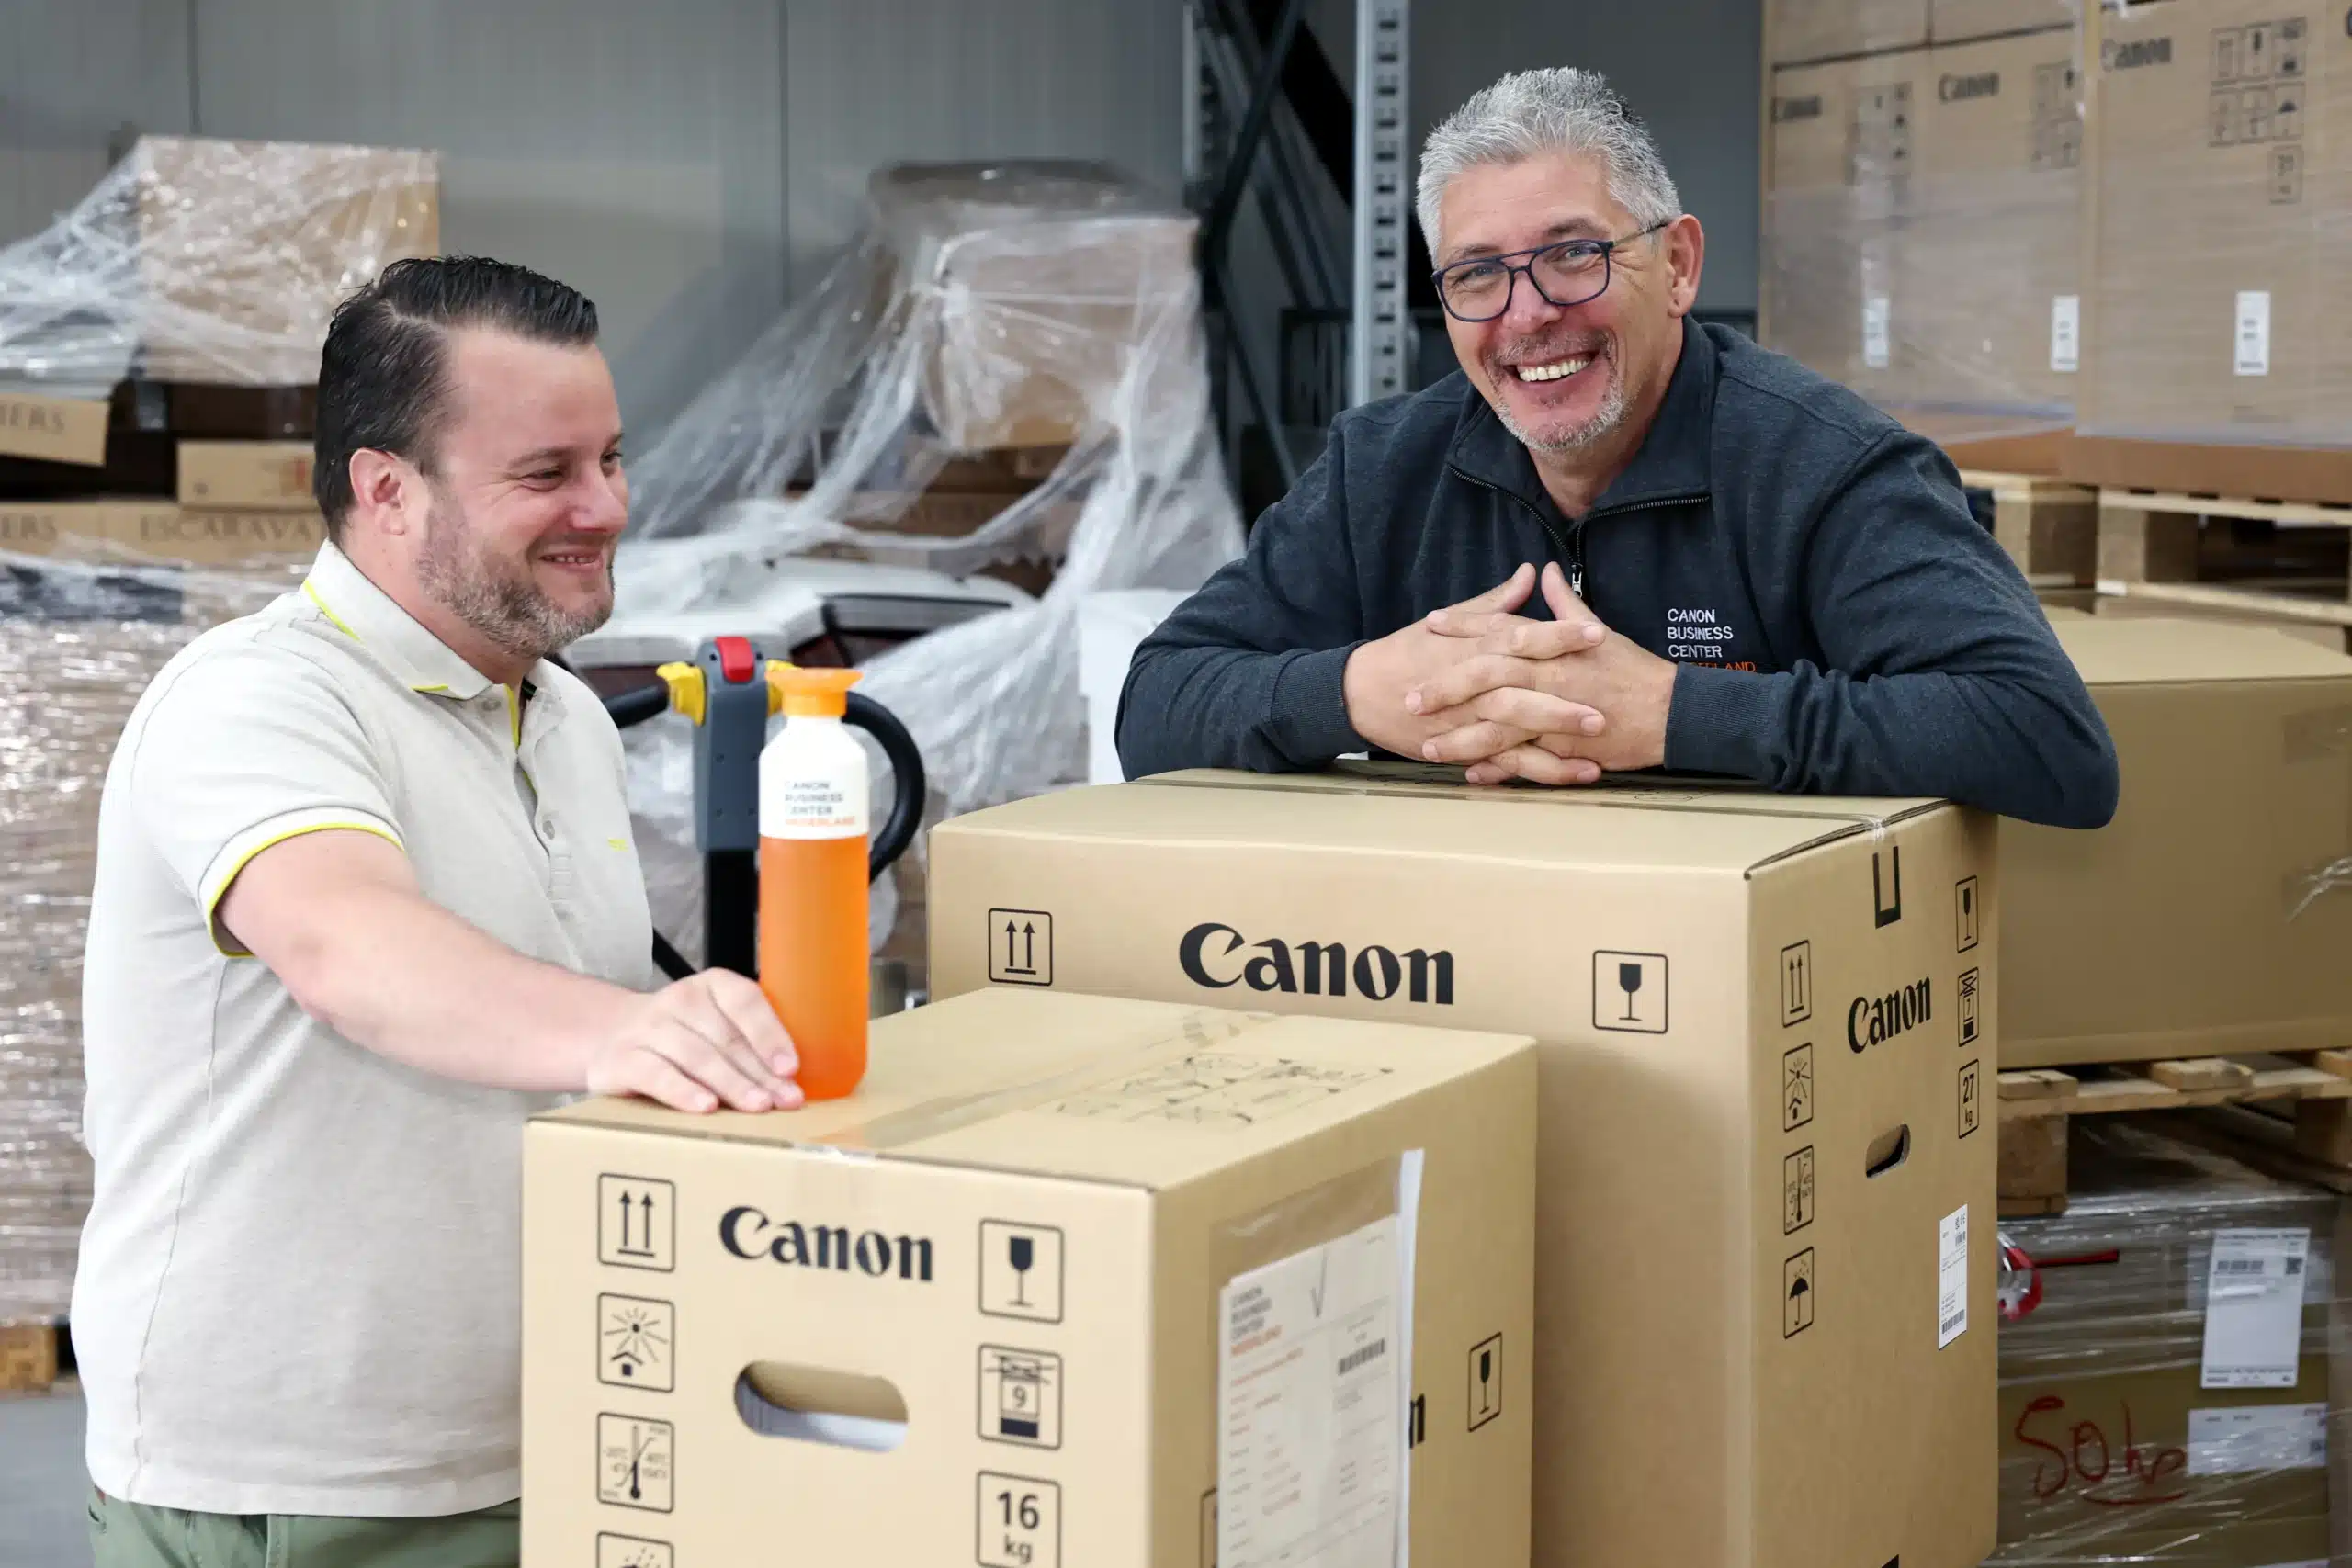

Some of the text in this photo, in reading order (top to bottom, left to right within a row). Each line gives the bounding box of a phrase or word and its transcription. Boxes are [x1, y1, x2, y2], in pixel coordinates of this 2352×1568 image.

[1668, 608, 1715, 623] CANON
[1668, 626, 1734, 640] BUSINESS
[1668, 645, 1723, 658] CENTER
[1180, 922, 1453, 1005] Canon
[1848, 976, 1930, 1054] Canon
[1962, 1072, 1974, 1104] 27
[719, 1205, 933, 1281] Canon
[1012, 1385, 1027, 1408] 9
[997, 1491, 1040, 1530] 16
[1004, 1533, 1032, 1565] kg
